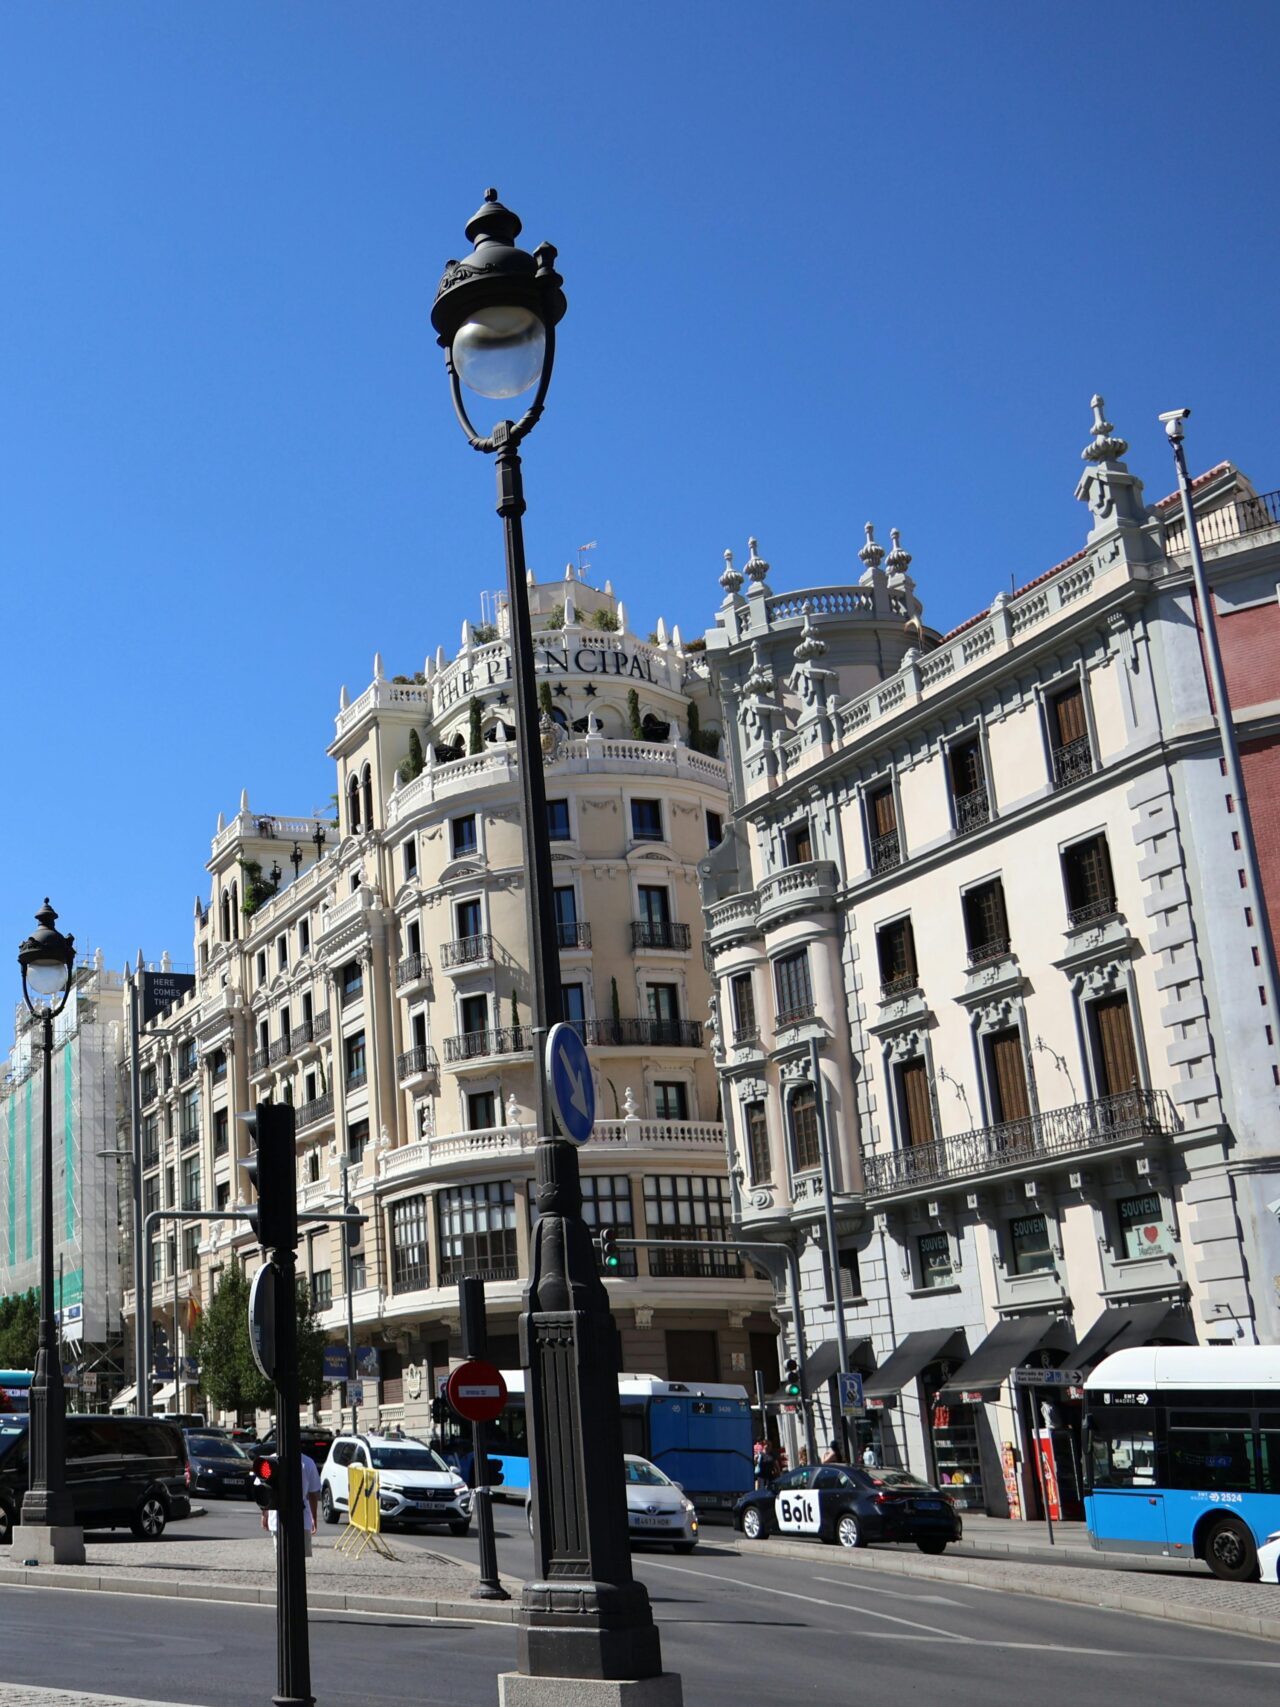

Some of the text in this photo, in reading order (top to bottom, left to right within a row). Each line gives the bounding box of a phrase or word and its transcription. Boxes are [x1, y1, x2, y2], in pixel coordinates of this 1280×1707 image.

[486, 649, 659, 684] PNCIPAL
[153, 978, 175, 986] HERE
[153, 988, 181, 996] COMES
[154, 998, 169, 1006] THE
[1135, 1228, 1143, 1246] I
[1221, 1493, 1243, 1503] 2524
[782, 1499, 815, 1523] Bolt
